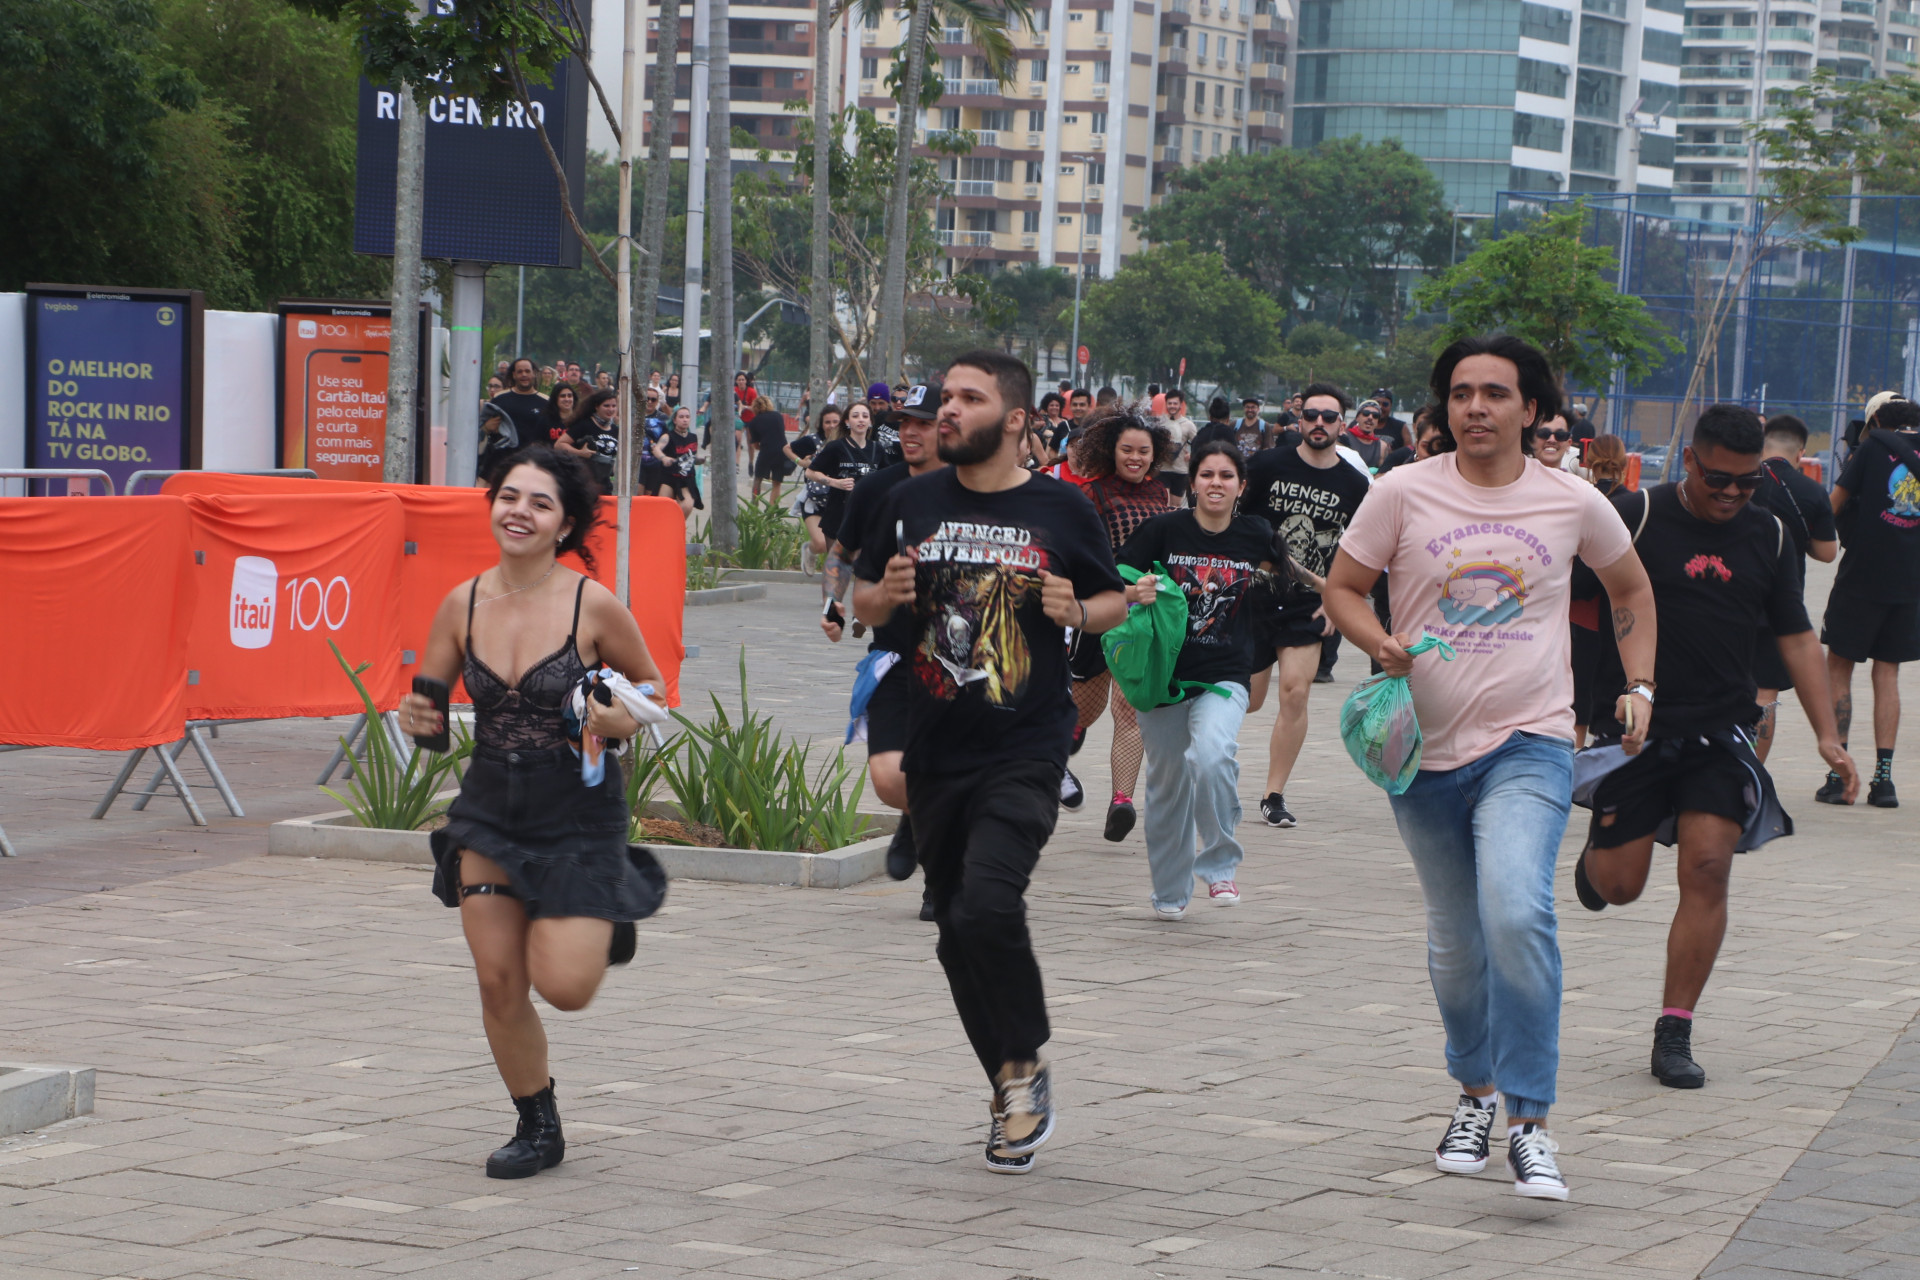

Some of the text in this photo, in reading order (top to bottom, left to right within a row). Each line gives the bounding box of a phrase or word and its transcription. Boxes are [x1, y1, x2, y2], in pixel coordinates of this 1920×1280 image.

[320, 324, 347, 337] 100
[48, 359, 153, 379] O MELHOR
[48, 380, 78, 397] DO
[317, 375, 363, 388] Use seu
[317, 390, 386, 404] Cartão Itaú
[48, 401, 171, 421] ROCK IN RIO
[316, 405, 384, 419] pelo celular
[47, 417, 106, 440] TÁ NA
[316, 422, 358, 433] e curta
[47, 441, 152, 462] TV GLOBO.
[316, 436, 373, 449] com mais
[315, 452, 380, 468] segurança
[1270, 479, 1341, 507] AVENGED
[1268, 495, 1348, 524] SEVENFOLD
[933, 521, 1031, 546] AVENGED
[918, 540, 1040, 569] SEVENFOLD
[1425, 522, 1552, 567] Evanescence
[1167, 552, 1255, 572] AVENGED SEVENFOL
[234, 576, 350, 631] itaú 100
[1423, 624, 1534, 641] wake me up inside
